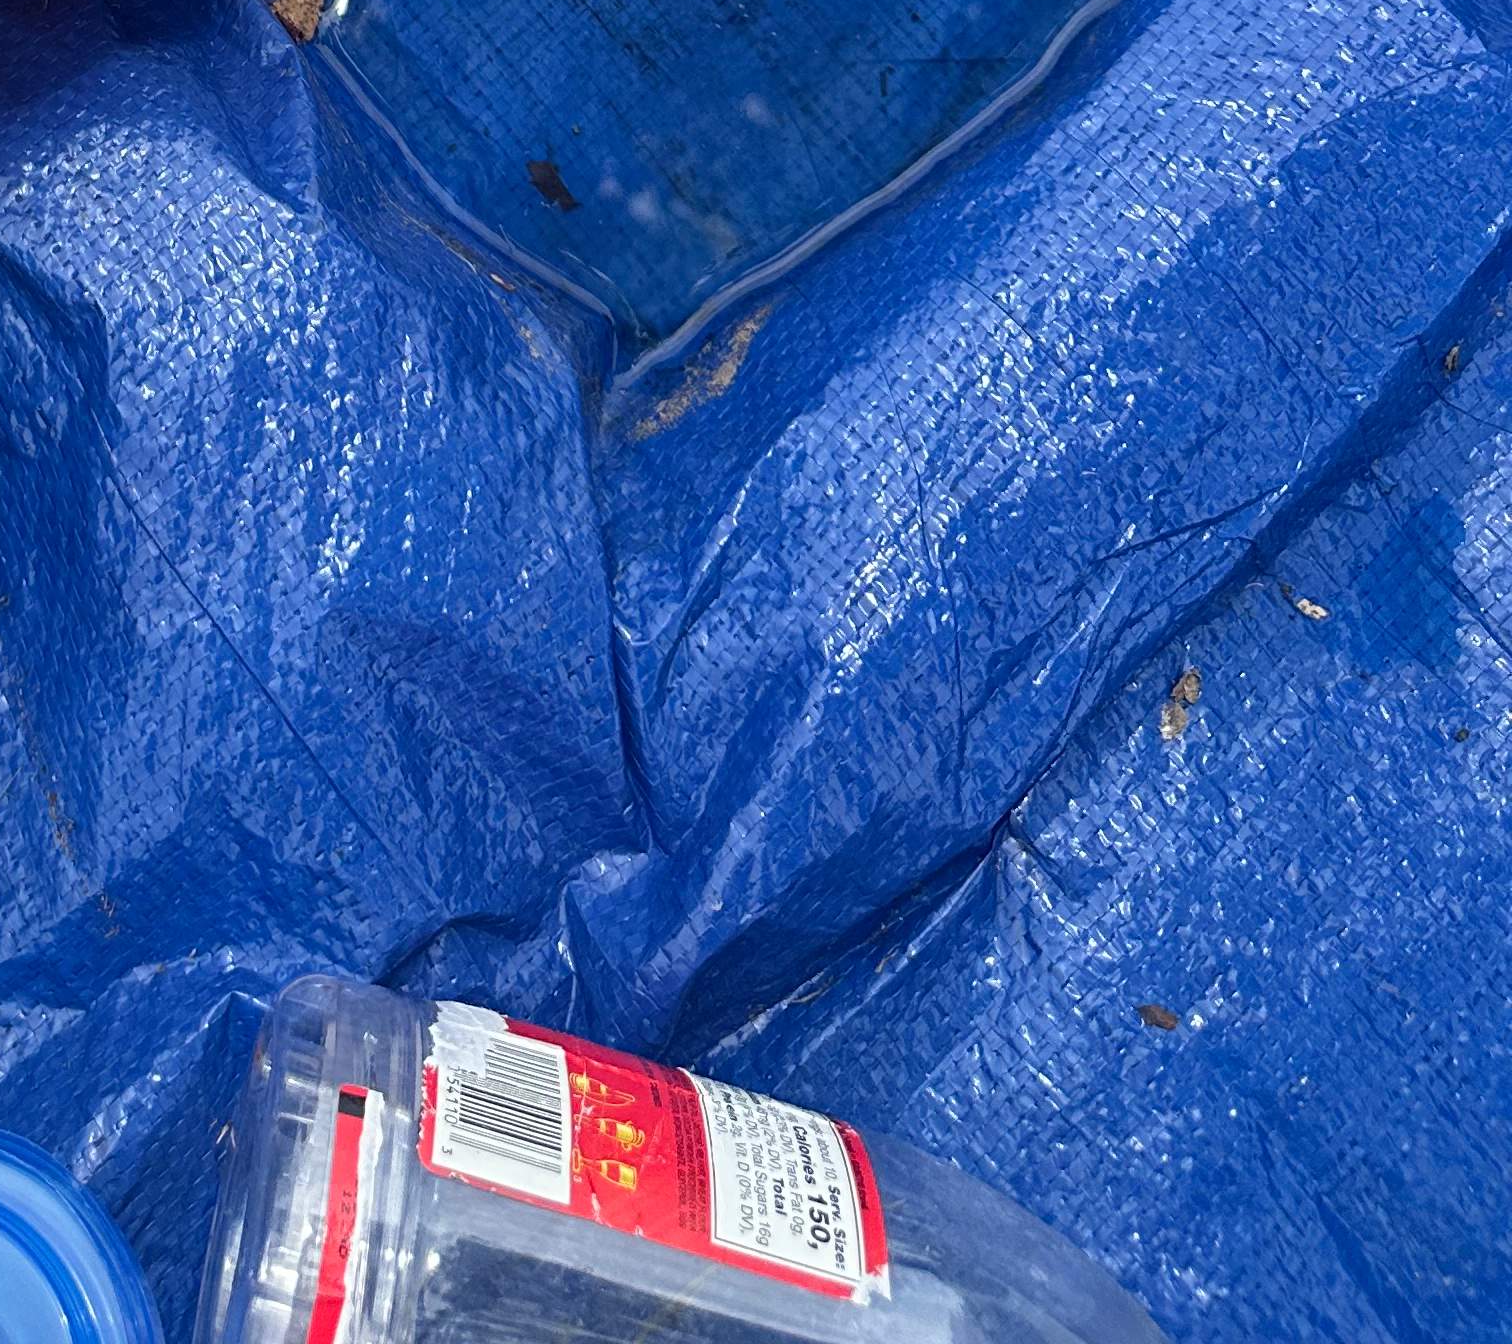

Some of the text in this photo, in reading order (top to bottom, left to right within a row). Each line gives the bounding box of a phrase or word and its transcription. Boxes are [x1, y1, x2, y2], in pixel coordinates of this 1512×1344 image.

[753, 1171, 769, 1218] Sugars
[772, 1177, 788, 1217] Total
[792, 1124, 817, 1186] Calories
[807, 1193, 831, 1250] 150,
